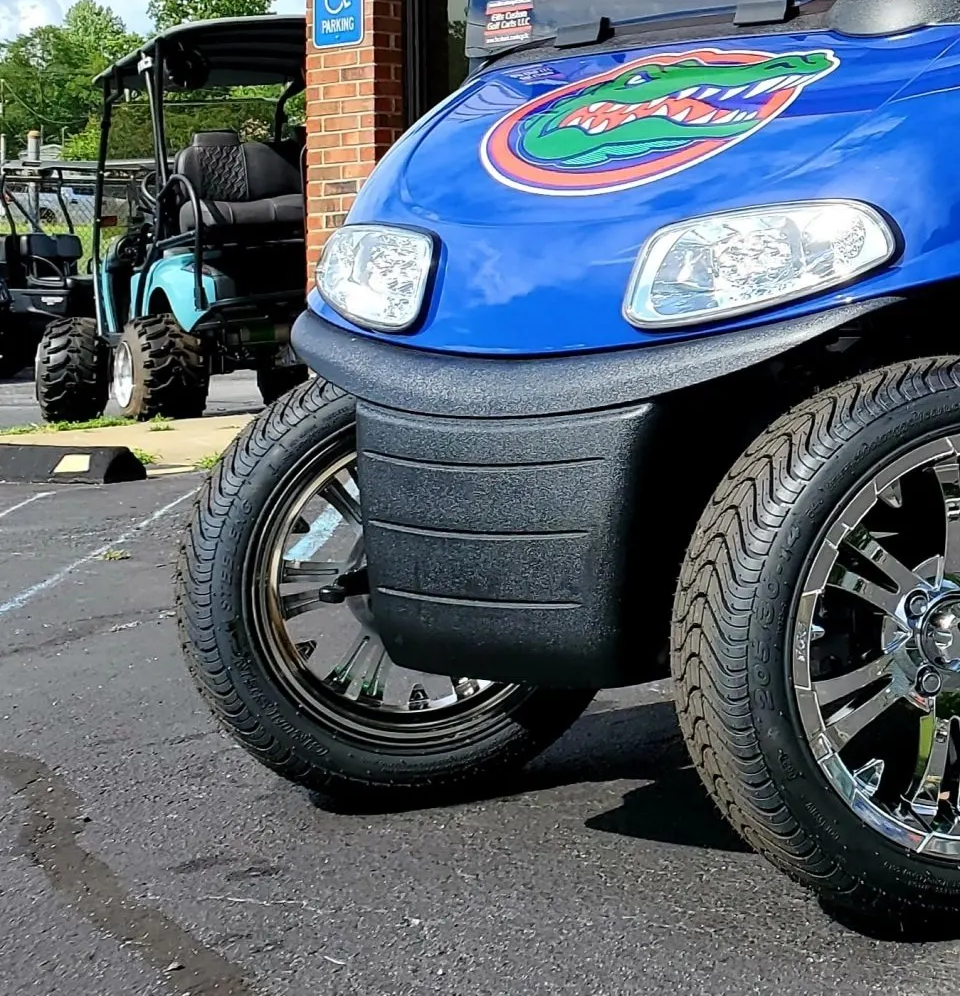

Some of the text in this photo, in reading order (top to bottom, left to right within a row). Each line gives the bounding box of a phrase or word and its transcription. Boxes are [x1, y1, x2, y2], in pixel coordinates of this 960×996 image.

[321, 17, 355, 34] PARKING
[487, 17, 531, 30] Golf Carts LLC
